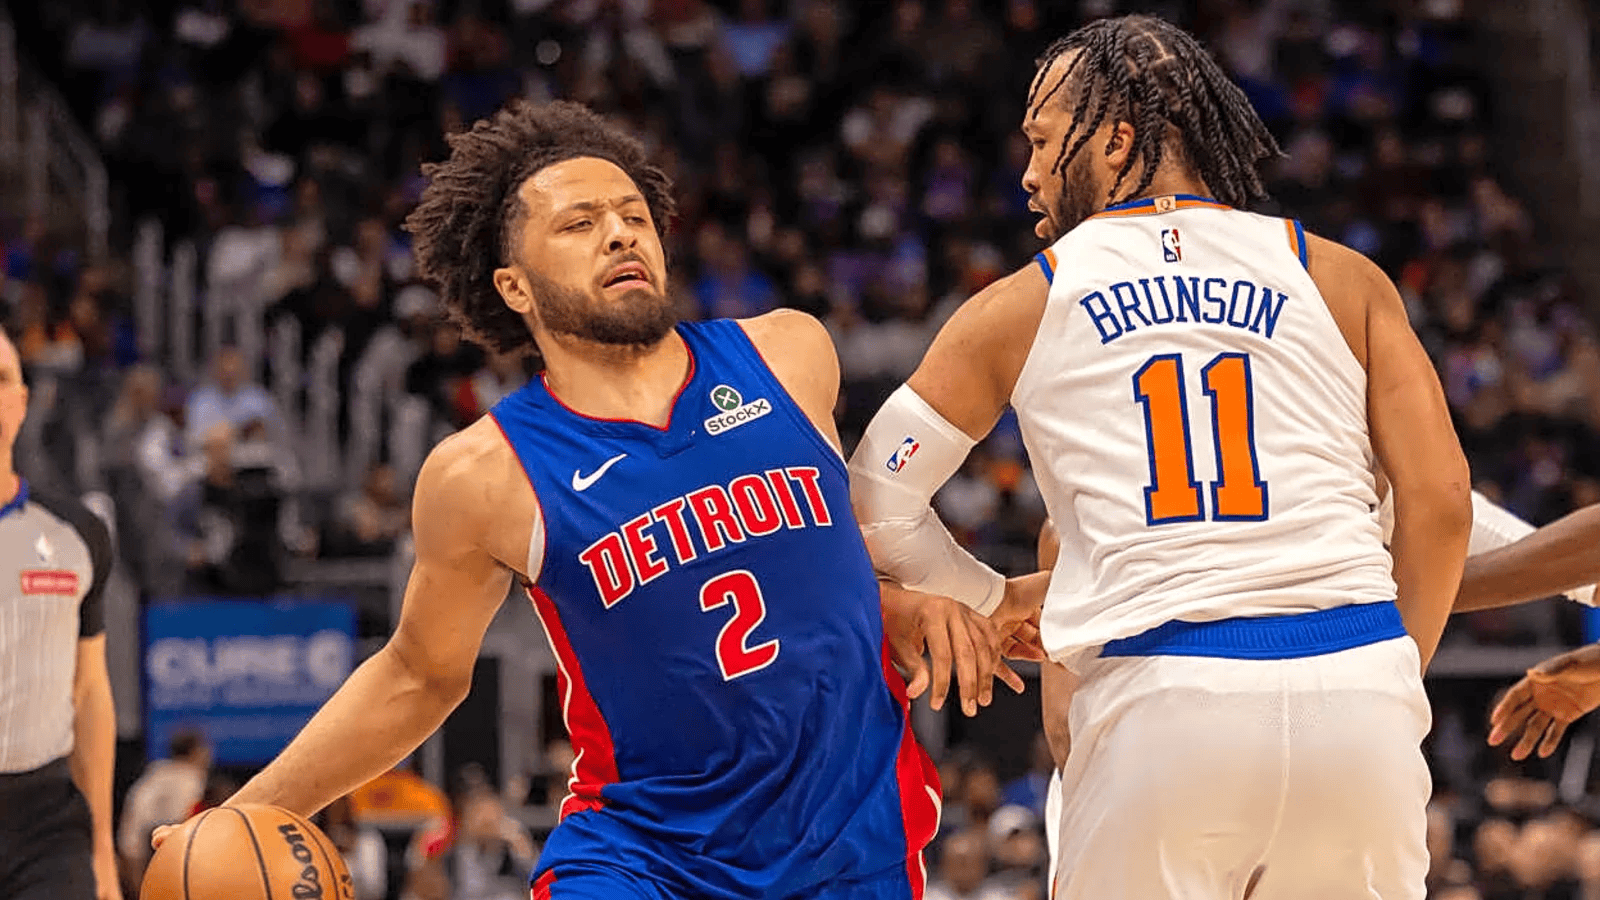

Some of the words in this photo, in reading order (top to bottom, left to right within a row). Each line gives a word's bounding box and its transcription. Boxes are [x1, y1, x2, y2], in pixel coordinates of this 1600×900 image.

[1079, 275, 1288, 345] BRUNSON
[707, 400, 769, 432] StockX
[1132, 352, 1269, 527] 11
[578, 466, 833, 609] DETROIT
[699, 569, 780, 681] 2
